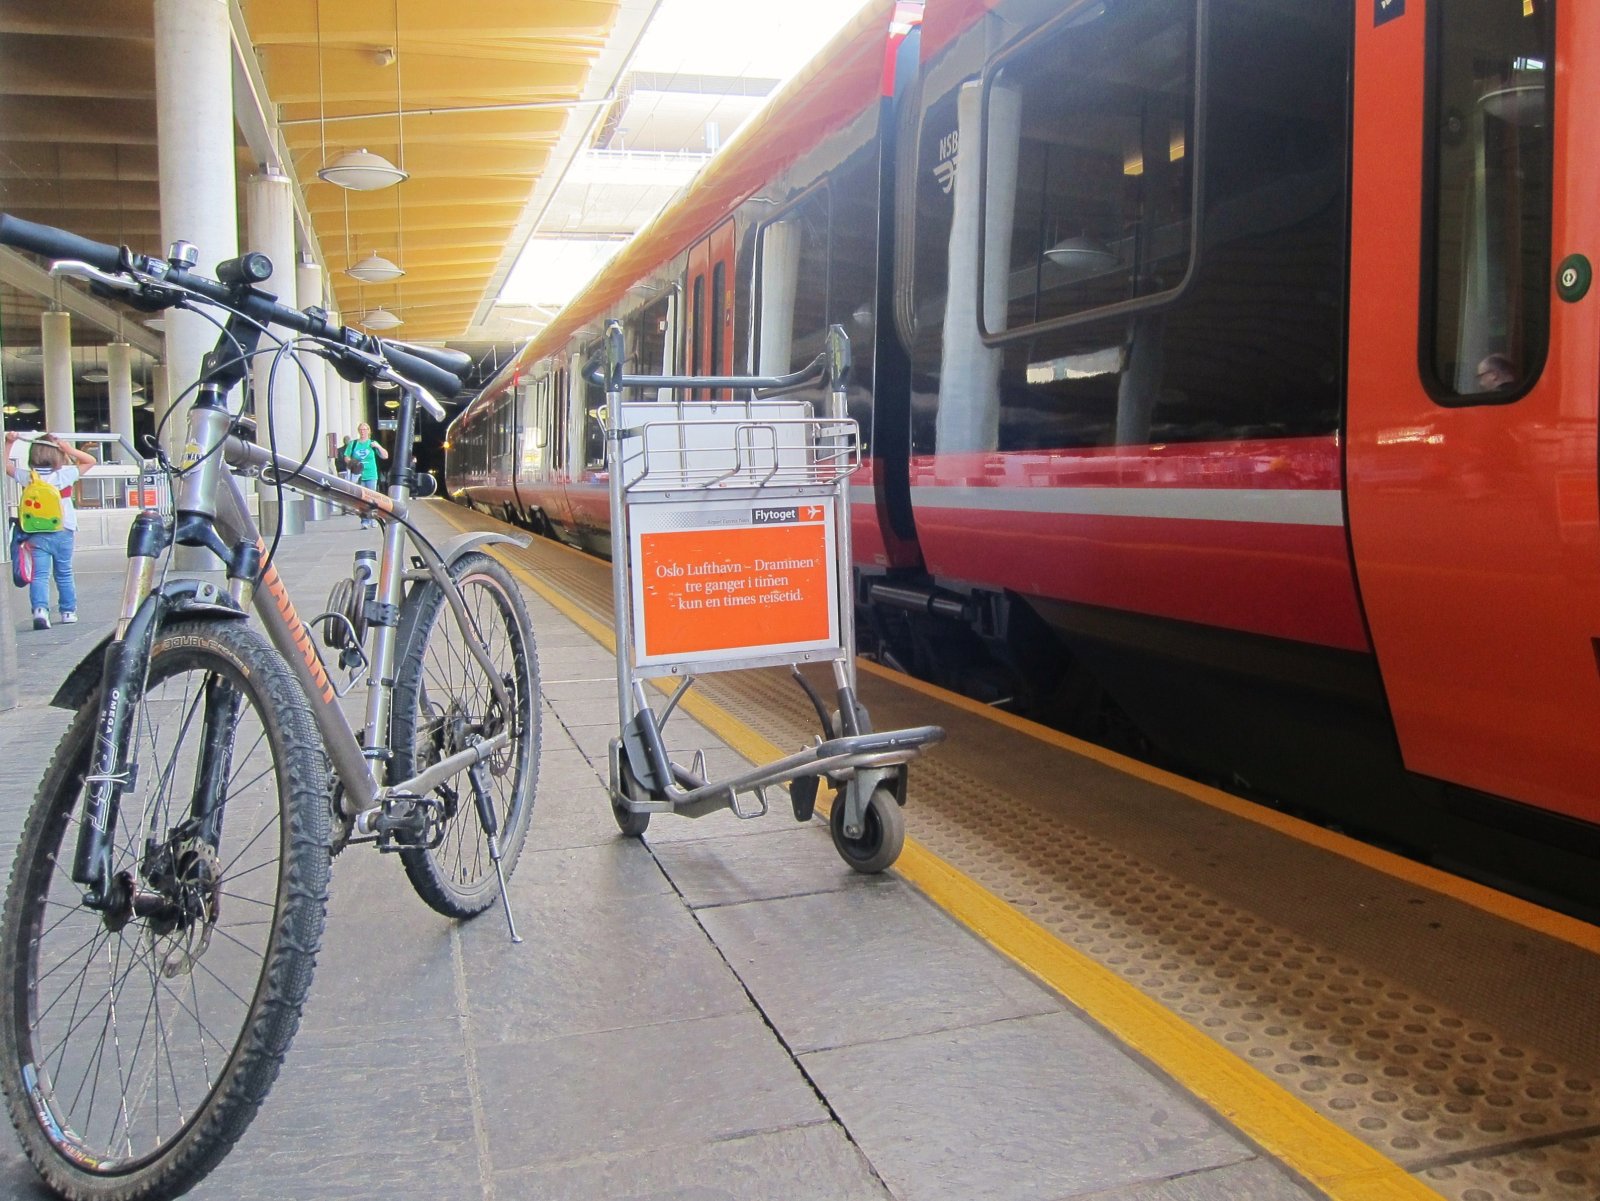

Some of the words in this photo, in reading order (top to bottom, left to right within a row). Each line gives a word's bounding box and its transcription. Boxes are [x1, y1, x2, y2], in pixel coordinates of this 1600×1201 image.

[940, 131, 958, 160] NSB
[755, 510, 796, 522] Flytoget
[656, 562, 684, 578] Oslo
[687, 561, 742, 576] Lufthavn
[755, 559, 814, 571] Drammen
[685, 582, 702, 593] tre
[705, 579, 746, 595] ganger
[748, 576, 752, 588] i
[755, 576, 789, 588] timen
[678, 597, 703, 610] kun
[706, 598, 721, 608] en
[723, 595, 756, 606] times
[105, 690, 120, 734] OMEGA
